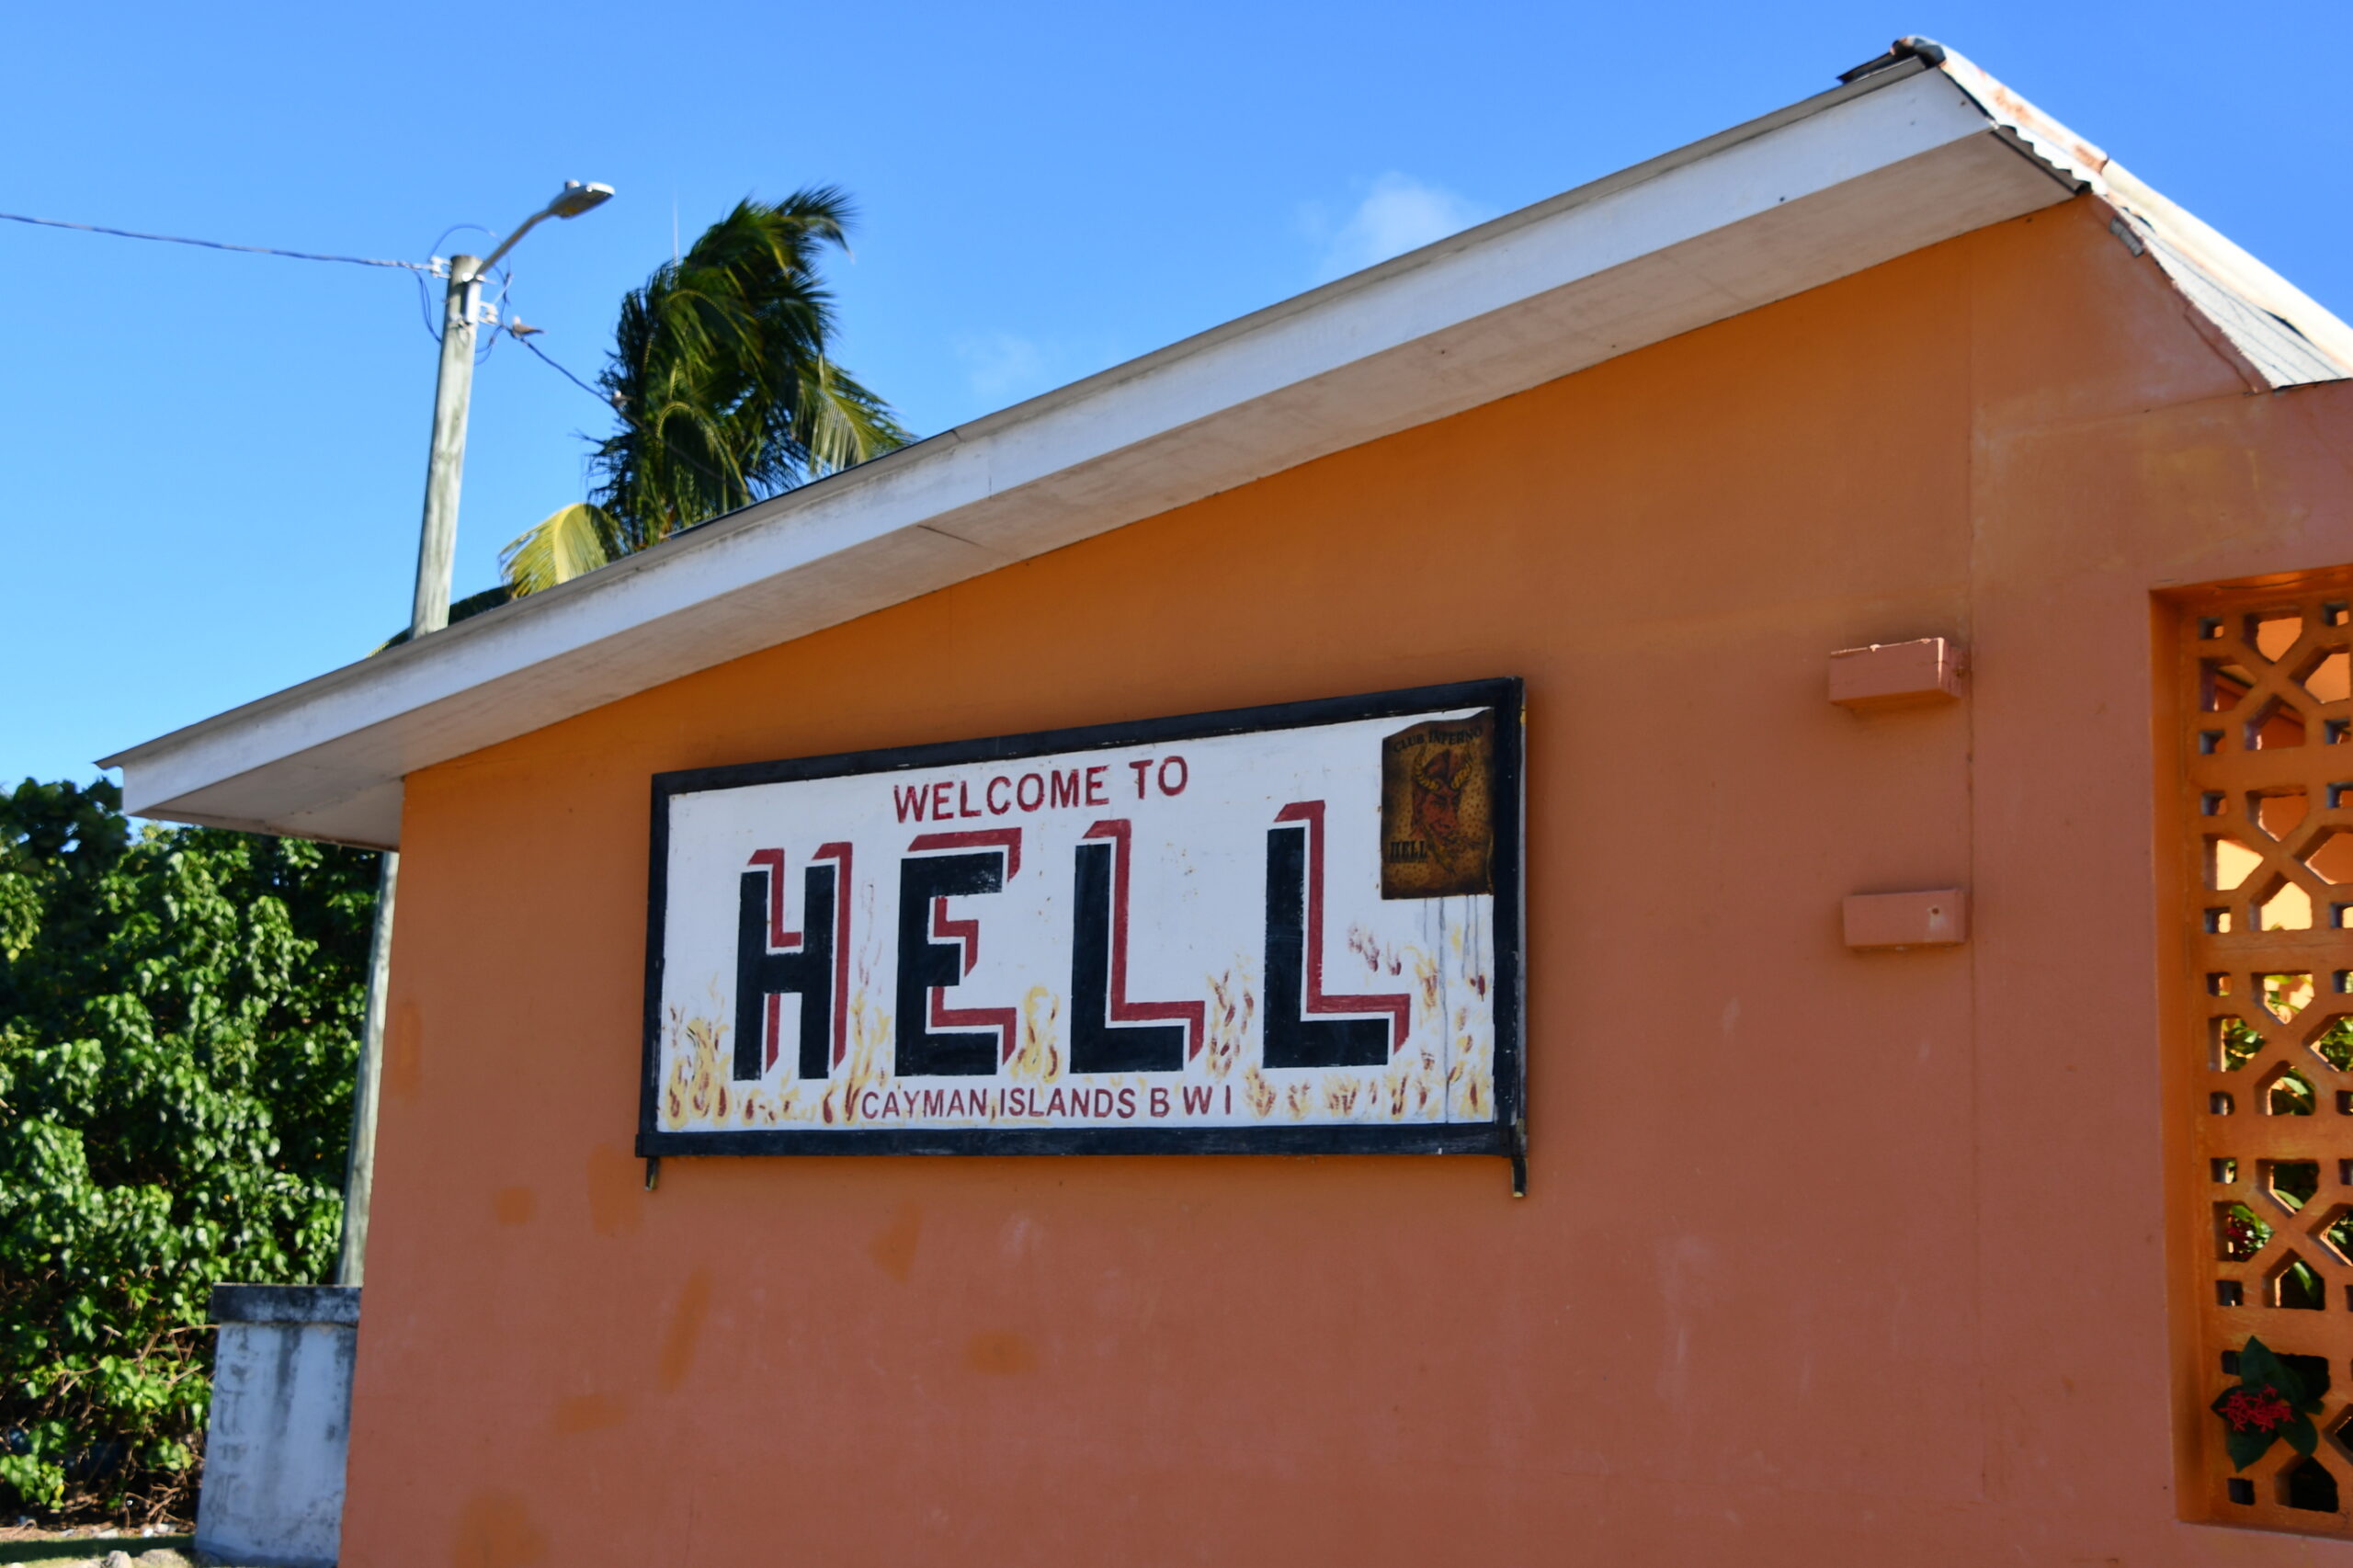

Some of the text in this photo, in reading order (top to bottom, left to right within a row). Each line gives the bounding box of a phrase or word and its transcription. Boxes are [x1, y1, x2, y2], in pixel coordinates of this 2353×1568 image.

[1393, 733, 1425, 753] CLUB
[893, 756, 1188, 824] WELCOME TO
[1390, 840, 1427, 858] HELL
[733, 800, 1411, 1082] HELL
[999, 1086, 1136, 1119] ISLANDS
